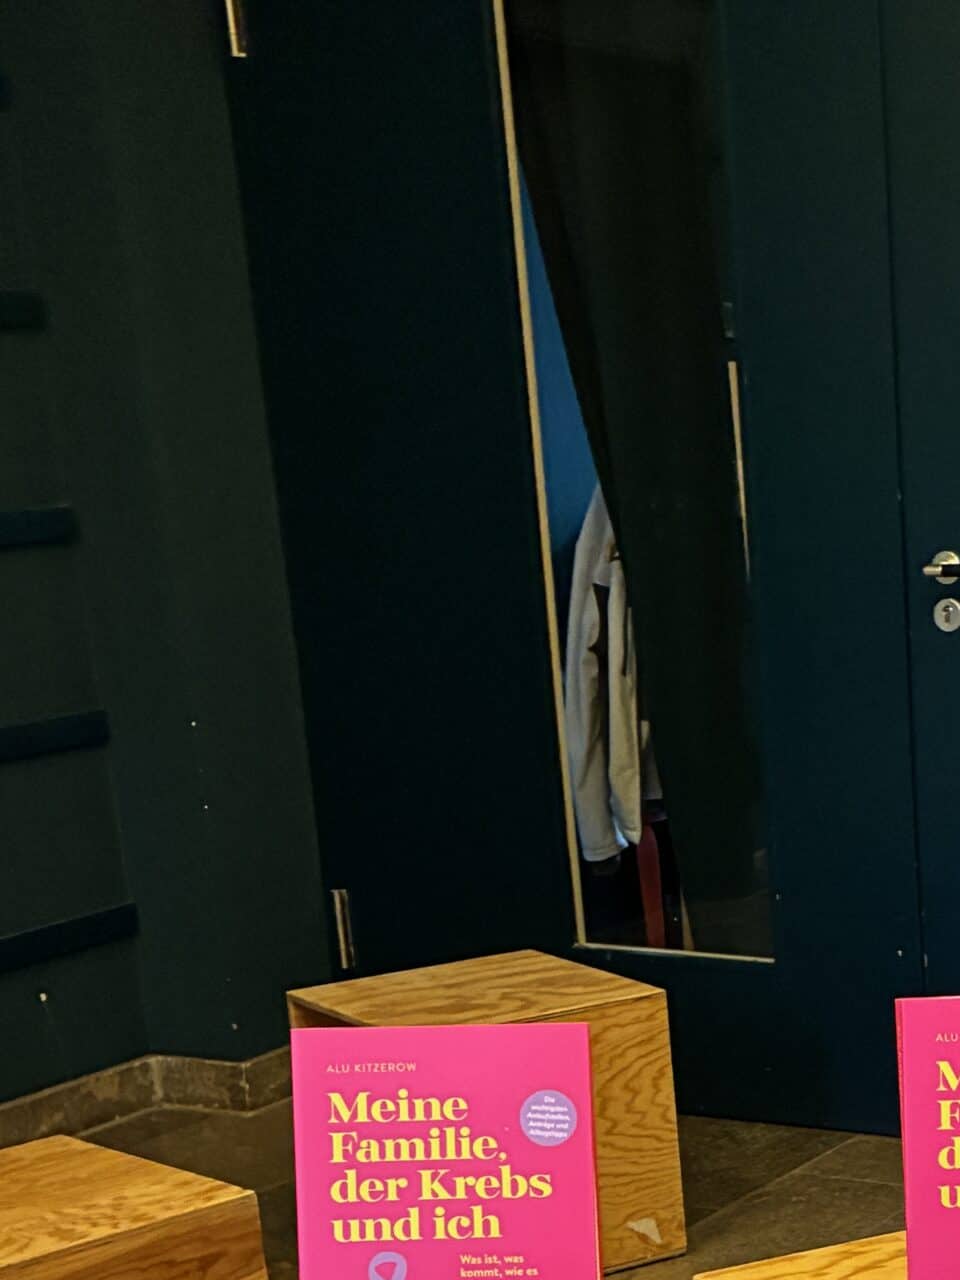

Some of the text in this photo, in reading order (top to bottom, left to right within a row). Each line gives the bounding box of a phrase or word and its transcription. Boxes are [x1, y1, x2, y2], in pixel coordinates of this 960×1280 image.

[936, 1032, 958, 1042] ALU
[326, 1061, 417, 1074] ALU KITZEROW
[327, 1089, 468, 1125] Meine
[328, 1127, 507, 1163] Familie,
[330, 1165, 553, 1203] der Krebs
[332, 1206, 503, 1243] und ich
[460, 1254, 481, 1264] Was
[504, 1255, 524, 1264] was
[505, 1266, 524, 1276] wie
[527, 1268, 538, 1276] es
